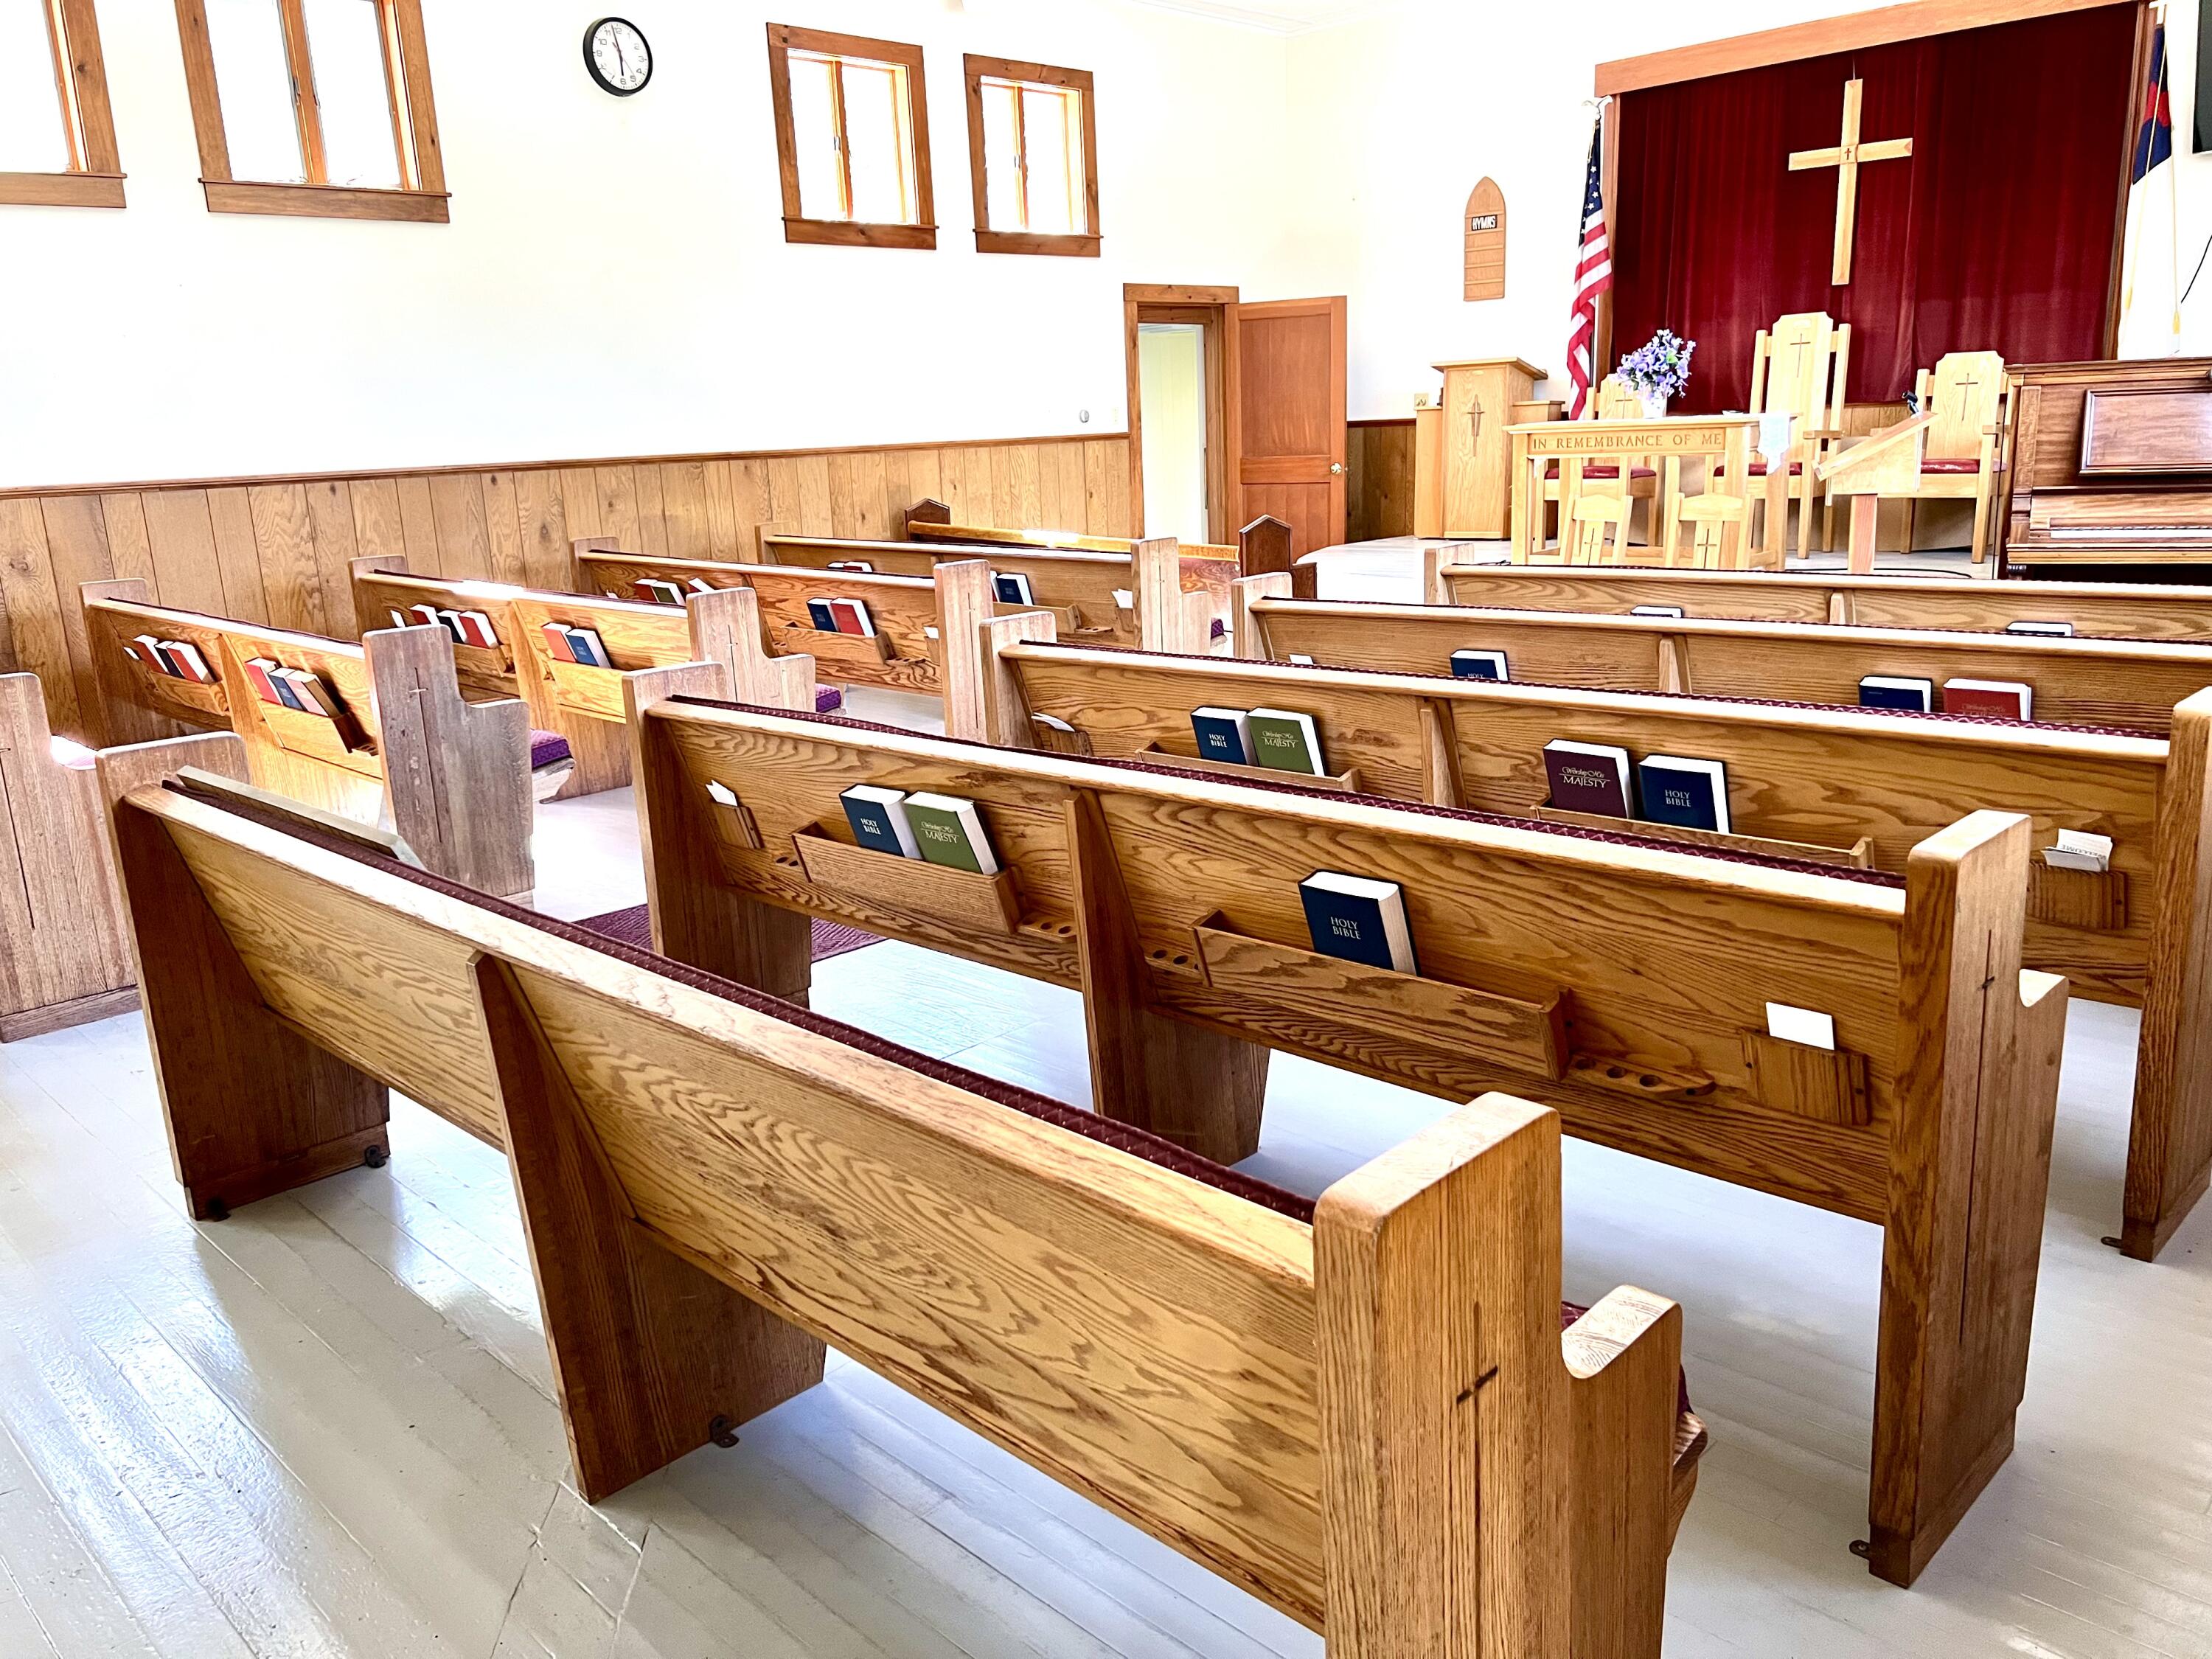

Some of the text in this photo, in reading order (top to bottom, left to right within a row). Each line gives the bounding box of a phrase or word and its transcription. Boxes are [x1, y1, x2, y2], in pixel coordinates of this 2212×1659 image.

[1472, 215, 1496, 230] HYMNS
[1534, 432, 1722, 449] IN REMEMBRANCE OF ME
[1209, 733, 1225, 741] HOLY
[1264, 737, 1296, 748] MAJESTY
[1210, 740, 1228, 748] BIBLE
[1563, 775, 1607, 788] MAJESTY
[1665, 789, 1690, 799] HOLY
[1666, 797, 1691, 807] BIBLE
[860, 818, 877, 827] HOLY
[863, 824, 881, 835] BIBLE
[925, 830, 958, 844] MAJESTY
[1330, 917, 1357, 930] HOLY
[1332, 925, 1362, 940] BIBLE
